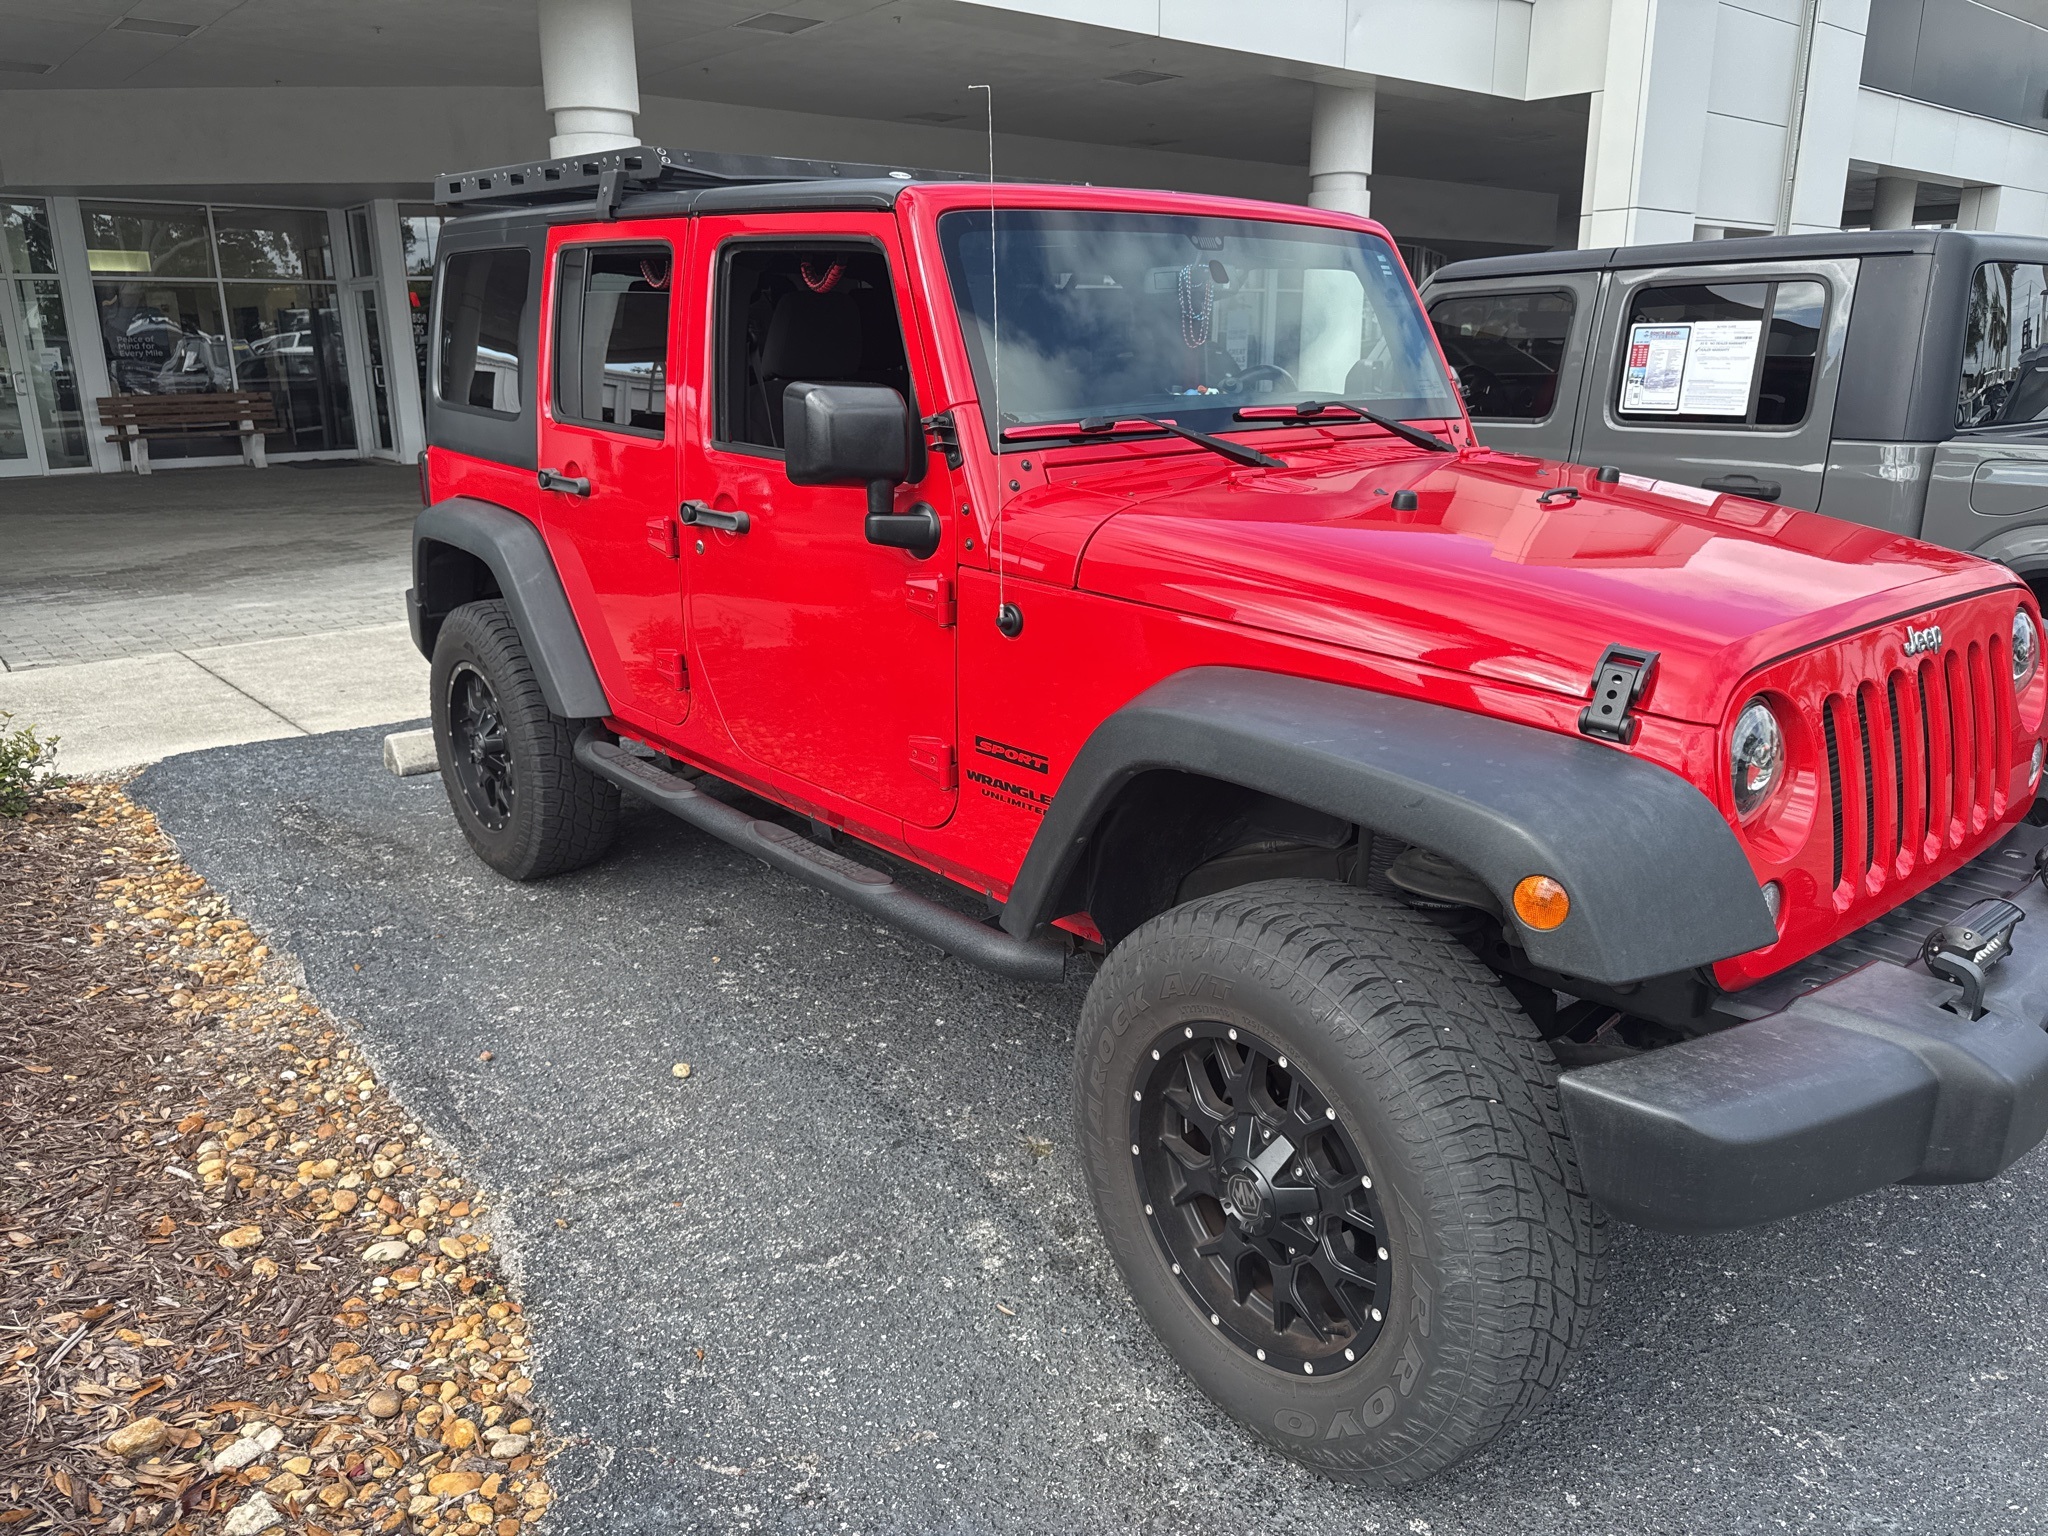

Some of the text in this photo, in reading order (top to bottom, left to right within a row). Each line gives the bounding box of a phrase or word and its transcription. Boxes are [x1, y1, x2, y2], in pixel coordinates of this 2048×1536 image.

[119, 350, 144, 358] Every
[1903, 625, 1942, 657] Jeep
[979, 740, 1048, 769] SPORT
[966, 769, 1054, 805] WRANGLE
[1160, 972, 1236, 1000] A/T
[1273, 1183, 1433, 1440] ARROYO
